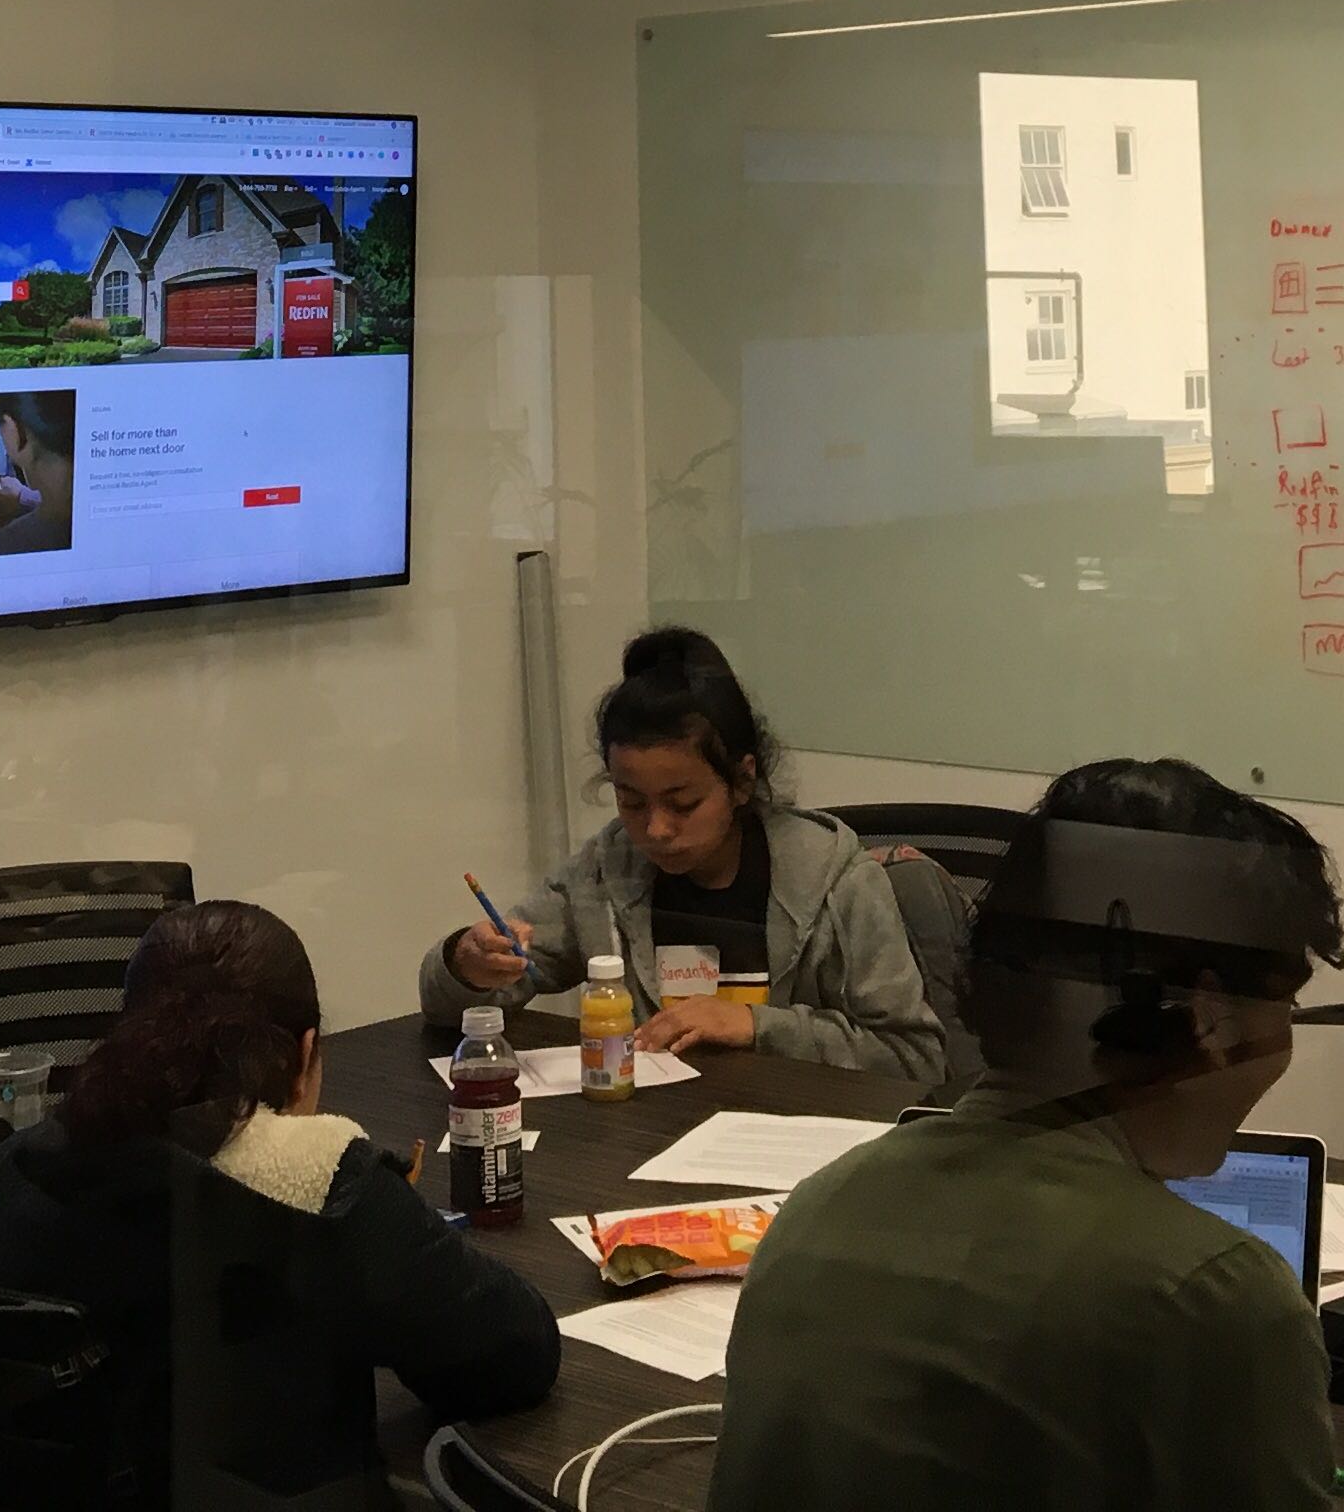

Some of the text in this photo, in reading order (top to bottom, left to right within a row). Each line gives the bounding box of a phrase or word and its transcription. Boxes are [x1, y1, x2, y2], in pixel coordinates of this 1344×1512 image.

[1270, 218, 1333, 238] Owner
[288, 305, 329, 321] REDFIN
[1271, 338, 1311, 368] Last
[90, 427, 178, 442] Sell for more than
[90, 443, 185, 458] the home next door
[659, 959, 720, 982] Samantha
